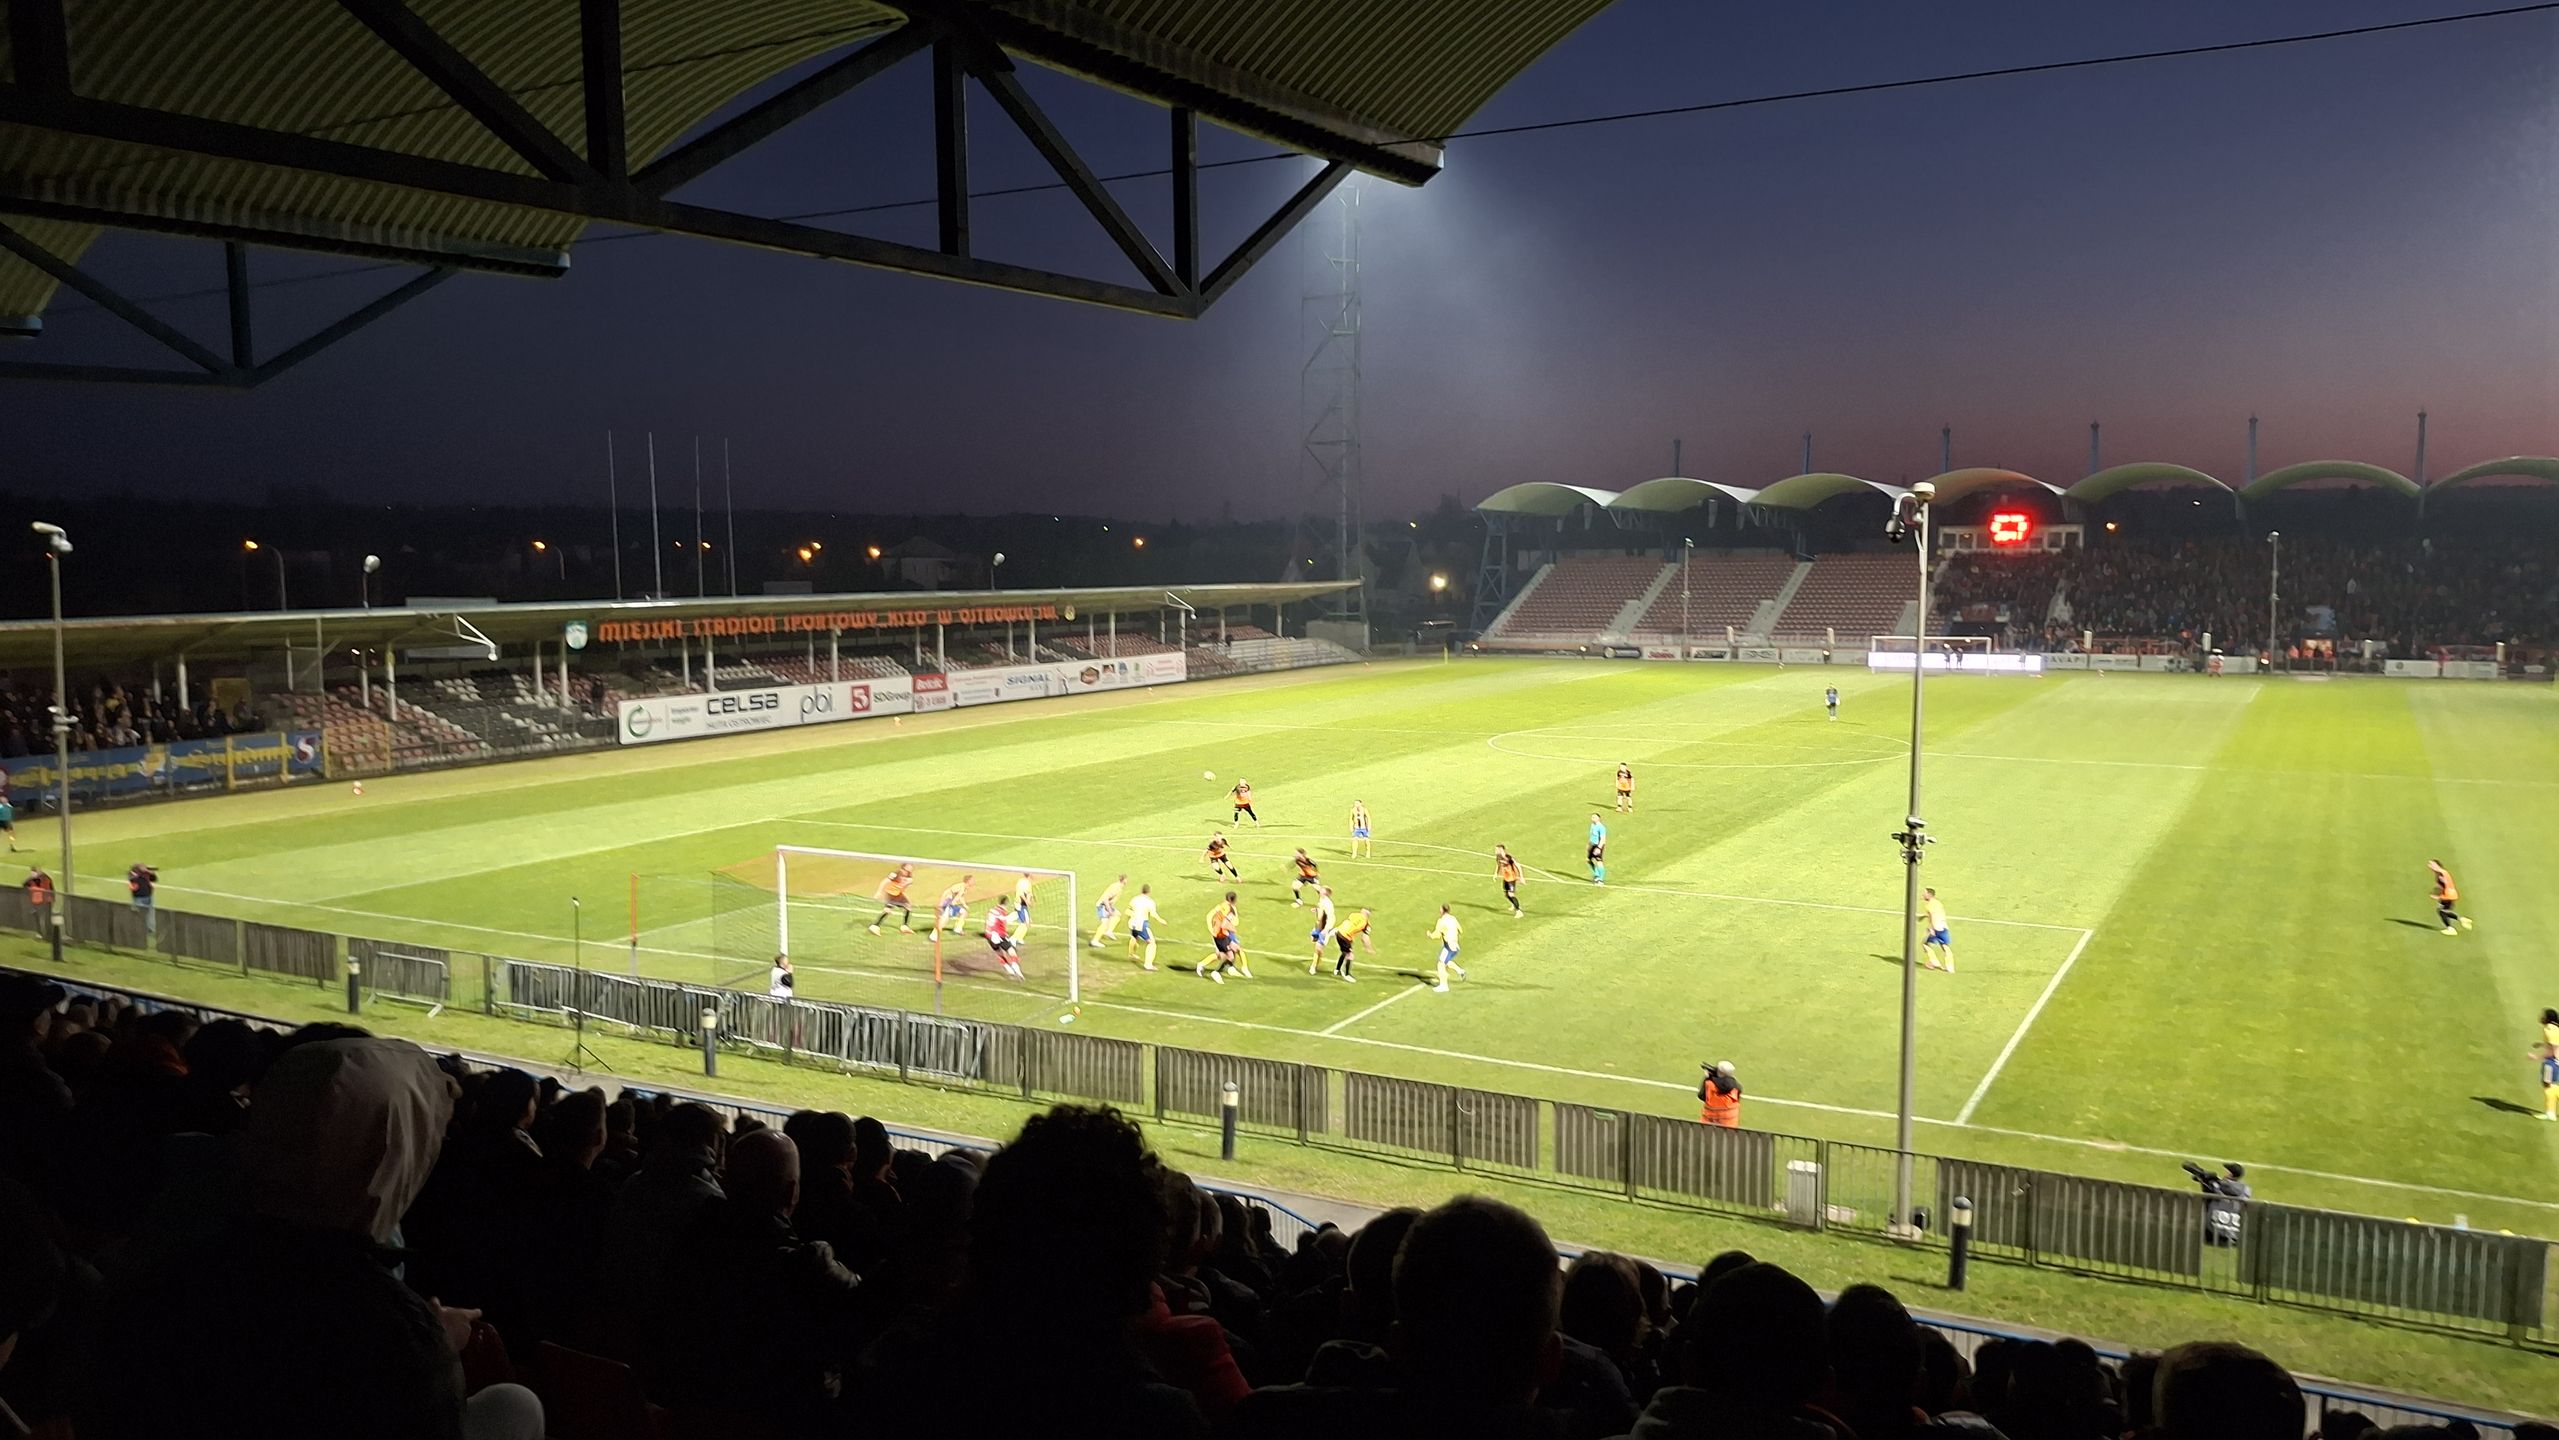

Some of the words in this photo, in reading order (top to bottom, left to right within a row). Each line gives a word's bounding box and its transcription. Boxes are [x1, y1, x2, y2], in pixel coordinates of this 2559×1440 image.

[599, 619, 684, 641] MIEJSKI
[693, 615, 776, 636] STADION
[783, 611, 878, 632] SPORTOWY
[937, 607, 952, 625] W
[801, 686, 833, 723] pbi
